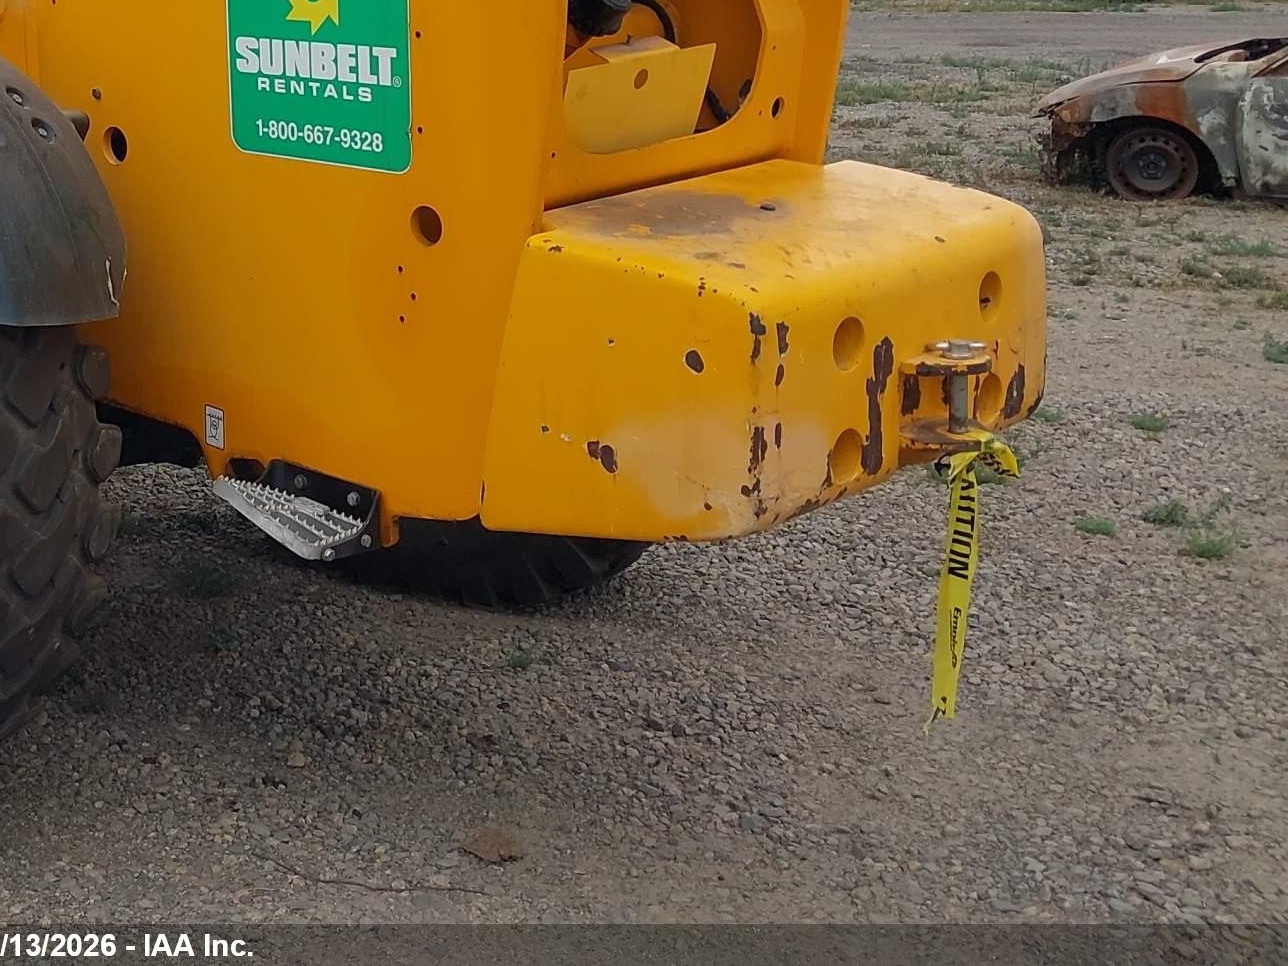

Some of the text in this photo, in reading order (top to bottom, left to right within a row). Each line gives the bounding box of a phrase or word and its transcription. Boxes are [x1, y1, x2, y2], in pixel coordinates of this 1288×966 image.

[257, 77, 373, 103] RENTALS
[255, 119, 384, 154] 1-800-667-9328
[948, 478, 975, 580] AUTION
